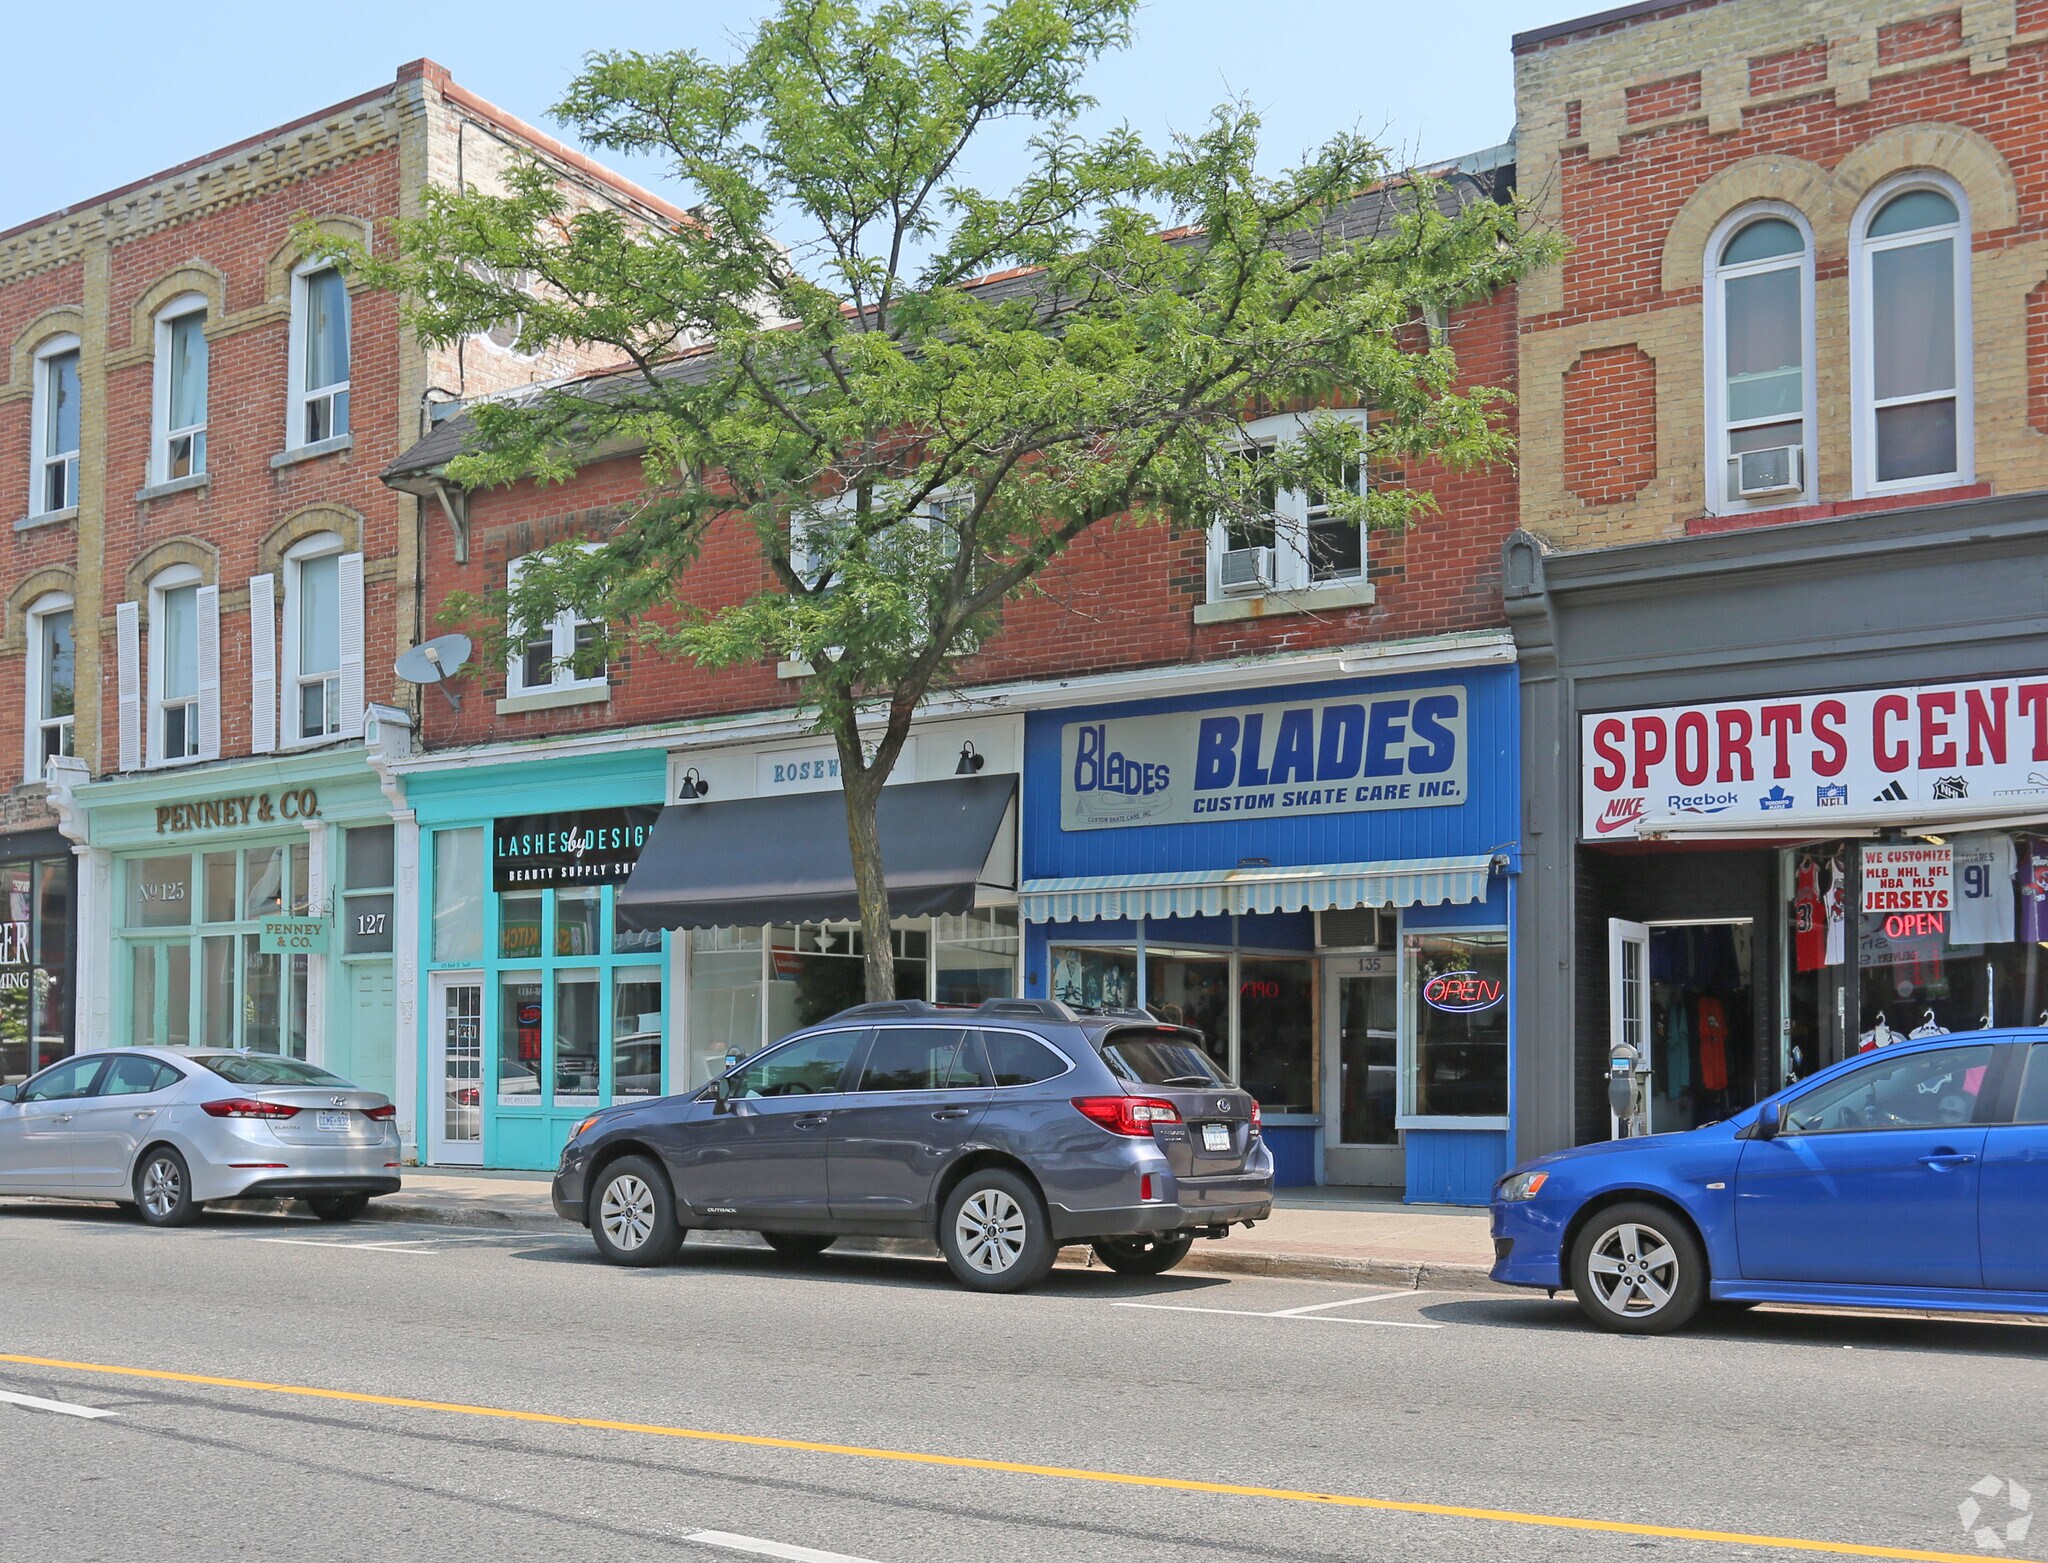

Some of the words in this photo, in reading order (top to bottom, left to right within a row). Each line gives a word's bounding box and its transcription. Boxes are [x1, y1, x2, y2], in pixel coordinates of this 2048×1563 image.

[1194, 694, 1459, 791] BLADES
[1593, 699, 1848, 792] SPORTS
[1074, 724, 1170, 795] BLADES
[774, 759, 839, 782] ROSEW
[1193, 793, 1275, 814] CUSTOM
[1282, 788, 1348, 808] SKATE
[1355, 783, 1410, 802] CARE
[1418, 779, 1462, 798] INC.
[1669, 792, 1738, 809] Reebok
[1940, 784, 1959, 798] NHL
[155, 796, 254, 833] PENNEY
[257, 793, 275, 822] &
[280, 787, 322, 820] CO.
[1605, 797, 1645, 816] NIKE
[1821, 797, 1843, 807] NFL
[1088, 815, 1109, 823] CUSTOM
[1109, 815, 1125, 824] SKATE
[498, 831, 568, 857] LASHES
[568, 826, 586, 857] by
[1865, 852, 1883, 864] WE
[1887, 850, 1951, 863] CUSTOMIZE
[1961, 852, 1995, 864] TAVARES
[509, 868, 553, 881] BEAUTY
[561, 864, 606, 877] SUPPLY
[1866, 867, 1889, 878] MLB
[1897, 867, 1920, 877] NHL
[1928, 866, 1949, 876] NFL
[1964, 864, 1991, 898] 91
[160, 881, 185, 901] 125
[1880, 878, 1904, 888] NBA
[1913, 877, 1935, 887] MLS
[1865, 889, 1949, 909] JERSEYS
[265, 923, 322, 935] PENNEY
[357, 914, 386, 935] 127
[1885, 912, 1944, 937] OPEN
[0, 921, 29, 965] ER
[277, 937, 286, 947] &
[290, 936, 312, 948] CO.
[1358, 958, 1381, 972] 135
[1427, 980, 1500, 1001] OPEN
[458, 1025, 475, 1038] OPEN
